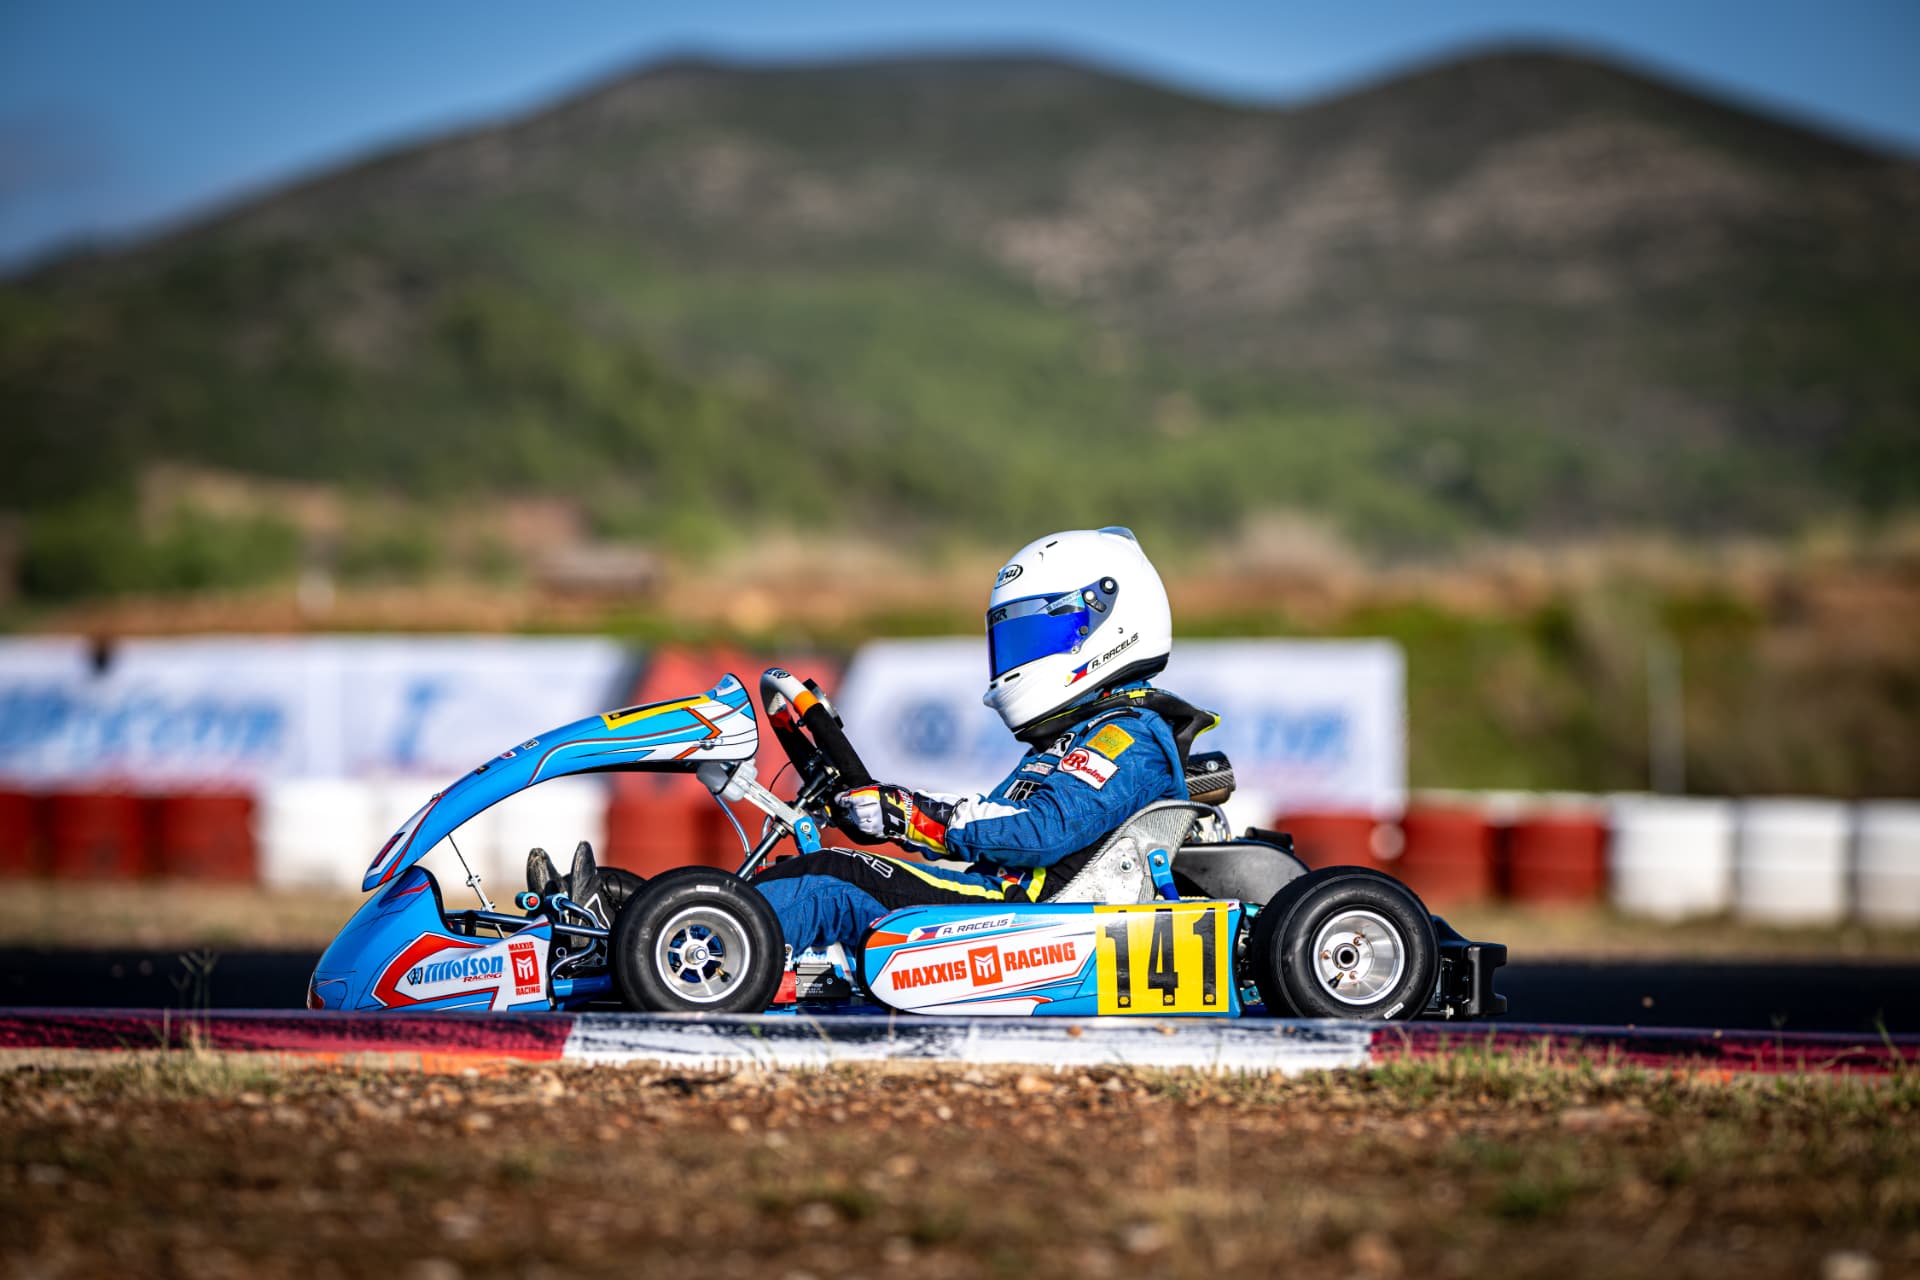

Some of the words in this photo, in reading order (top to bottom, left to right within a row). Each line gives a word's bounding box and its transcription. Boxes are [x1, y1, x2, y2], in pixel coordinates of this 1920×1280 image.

[1091, 659, 1102, 670] A.
[1102, 632, 1139, 663] RACELIS
[942, 926, 954, 936] A.
[956, 918, 1009, 933] RACELIS
[508, 941, 535, 952] MAXXIS
[1105, 907, 1217, 1008] 141
[892, 960, 968, 991] MAXXIS
[1003, 941, 1077, 972] RACING
[515, 985, 541, 997] RACING
